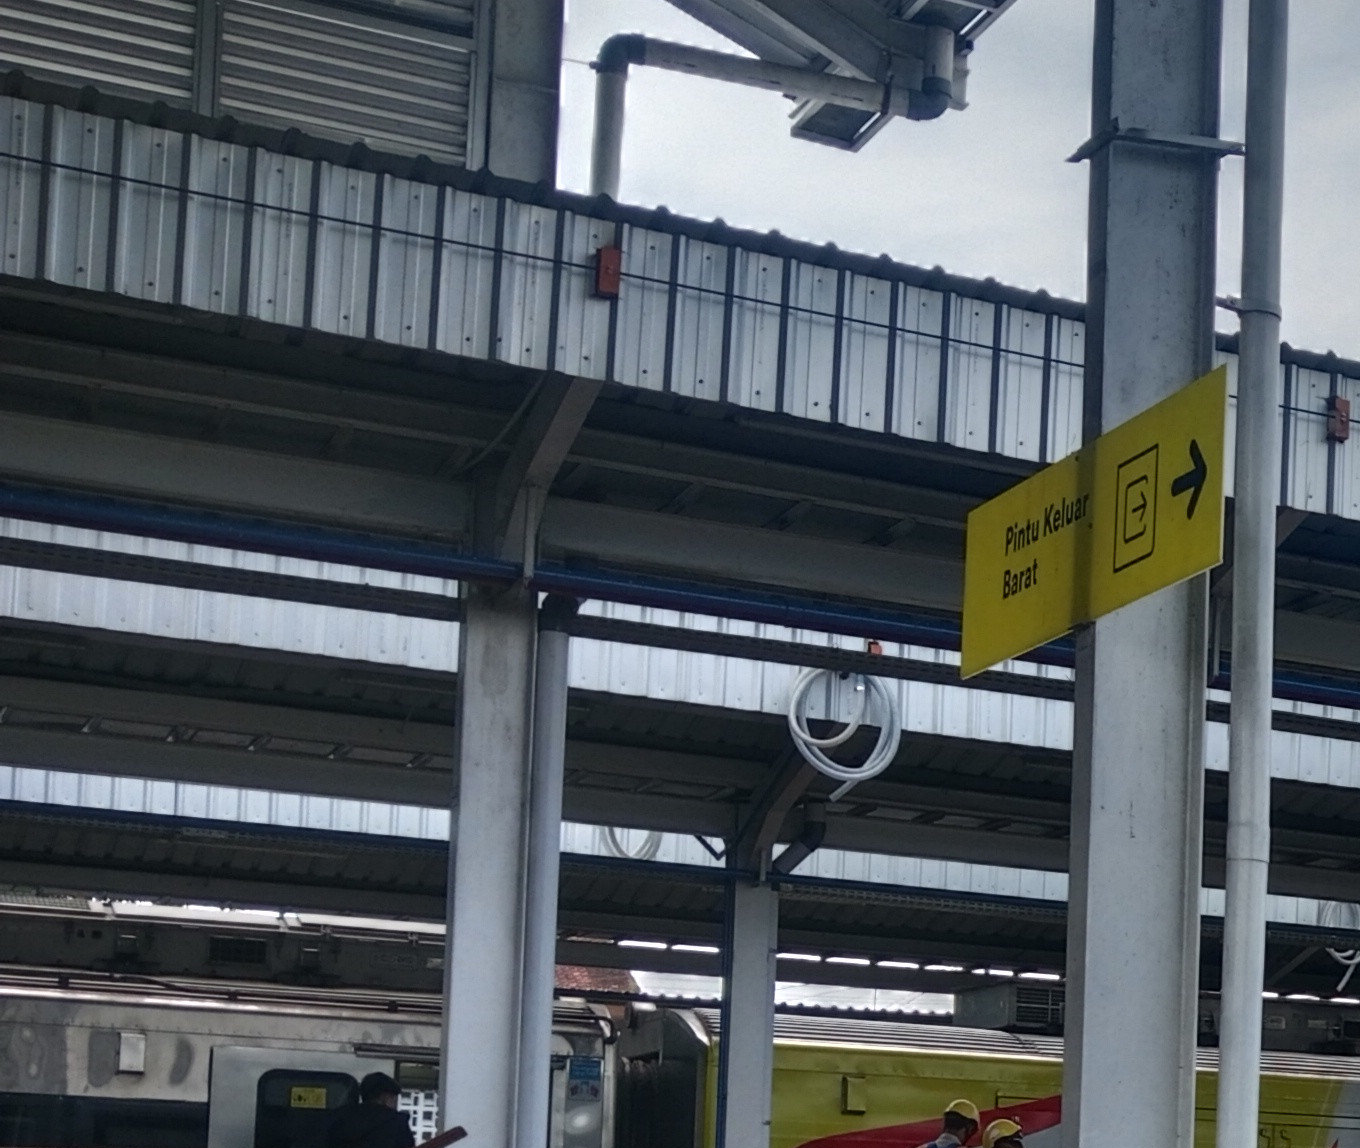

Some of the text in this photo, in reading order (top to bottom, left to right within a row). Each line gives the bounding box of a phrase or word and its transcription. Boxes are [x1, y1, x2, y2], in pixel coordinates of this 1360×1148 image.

[1004, 494, 1090, 557] Pintu Keluar
[1002, 558, 1038, 600] Barat
